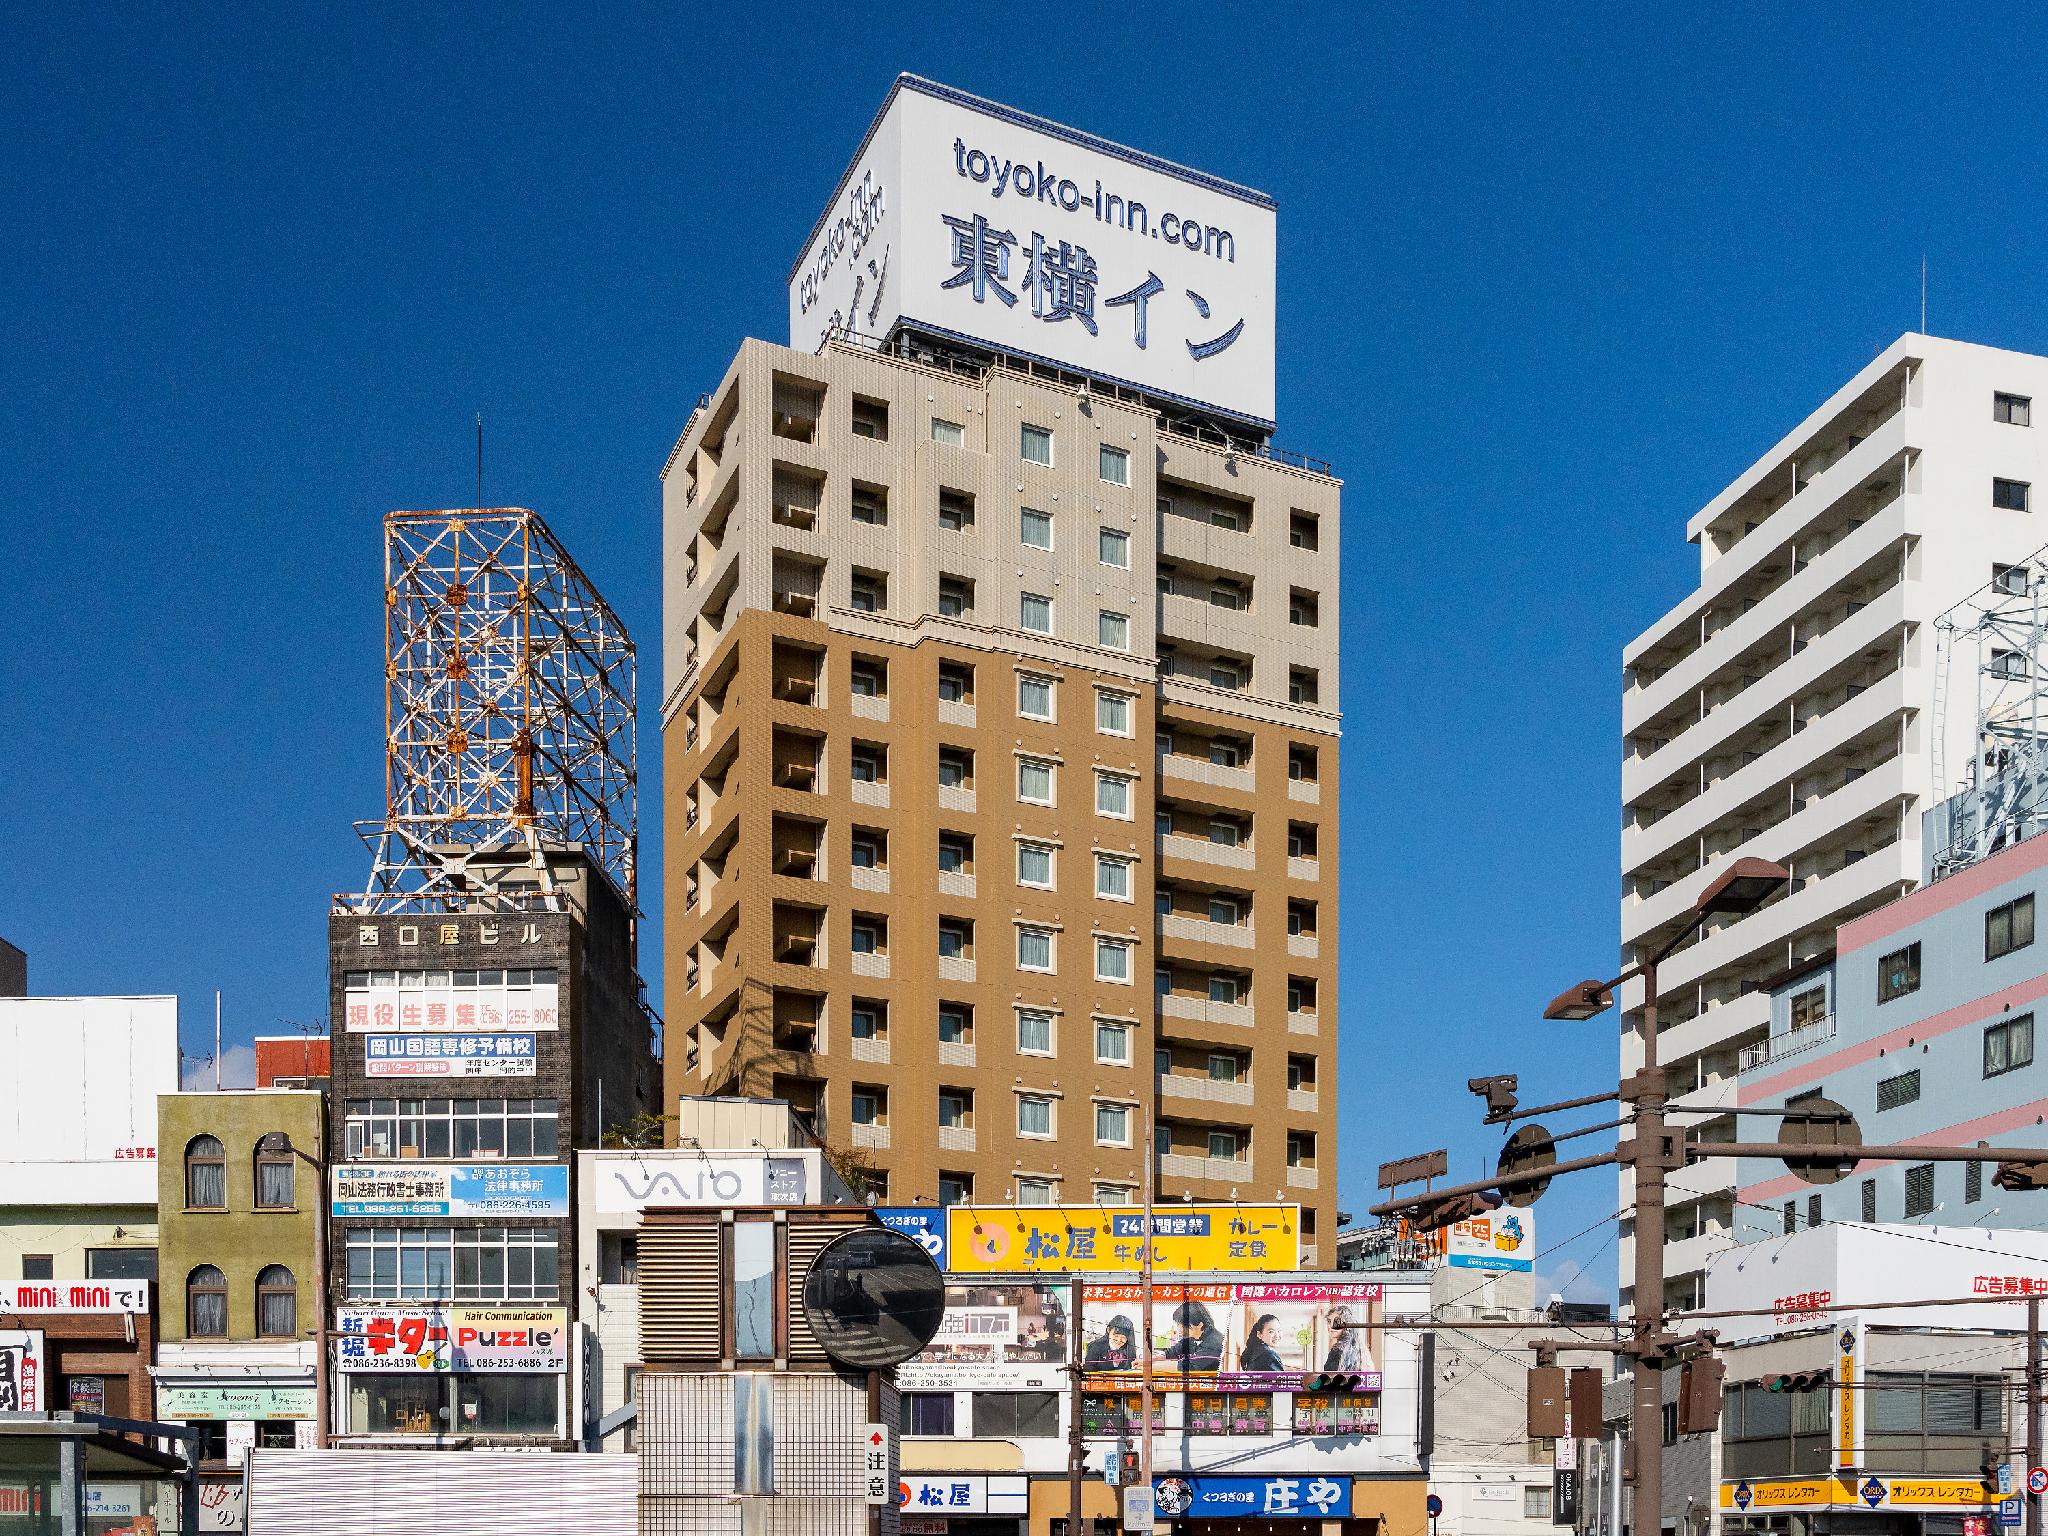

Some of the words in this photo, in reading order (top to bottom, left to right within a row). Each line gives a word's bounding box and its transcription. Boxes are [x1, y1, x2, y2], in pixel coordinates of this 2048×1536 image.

[953, 137, 1235, 263] toyoko-inn.com
[941, 213, 1245, 361] 東横イン
[359, 924, 542, 946] 西口屋ビル
[349, 1003, 476, 1025] 現役生募集
[370, 1037, 531, 1056] 岡山国語専修予備校
[115, 1147, 156, 1159] 広告募集
[485, 1168, 530, 1180] あおぞら
[484, 1180, 544, 1192] 法律事務所
[614, 1170, 743, 1200] VAIO
[770, 1180, 797, 1189] ストア
[1228, 1218, 1278, 1235] カレー
[1024, 1227, 1097, 1259] 松屋
[1229, 1240, 1267, 1258] 定食
[1973, 1276, 2048, 1296] 広告募集中
[70, 1286, 110, 1307] mini
[464, 1311, 484, 1321] Hair
[485, 1311, 553, 1321] Communication
[457, 1358, 475, 1368] TEL
[476, 1358, 541, 1368] 086-253-6886
[547, 1358, 564, 1368] 2F
[868, 1452, 885, 1496] 注意
[918, 1483, 970, 1506] 松屋
[1202, 1491, 1255, 1503] くつろぎの里
[1263, 1478, 1342, 1514] 庄や
[1757, 1488, 1785, 1500] オリックス
[1788, 1487, 1820, 1498] レンタカー
[1863, 1487, 1884, 1495] ORIX
[1893, 1487, 1935, 1498] オリックス
[1938, 1487, 1980, 1498] レンタカー
[2005, 1502, 2014, 1513] P
